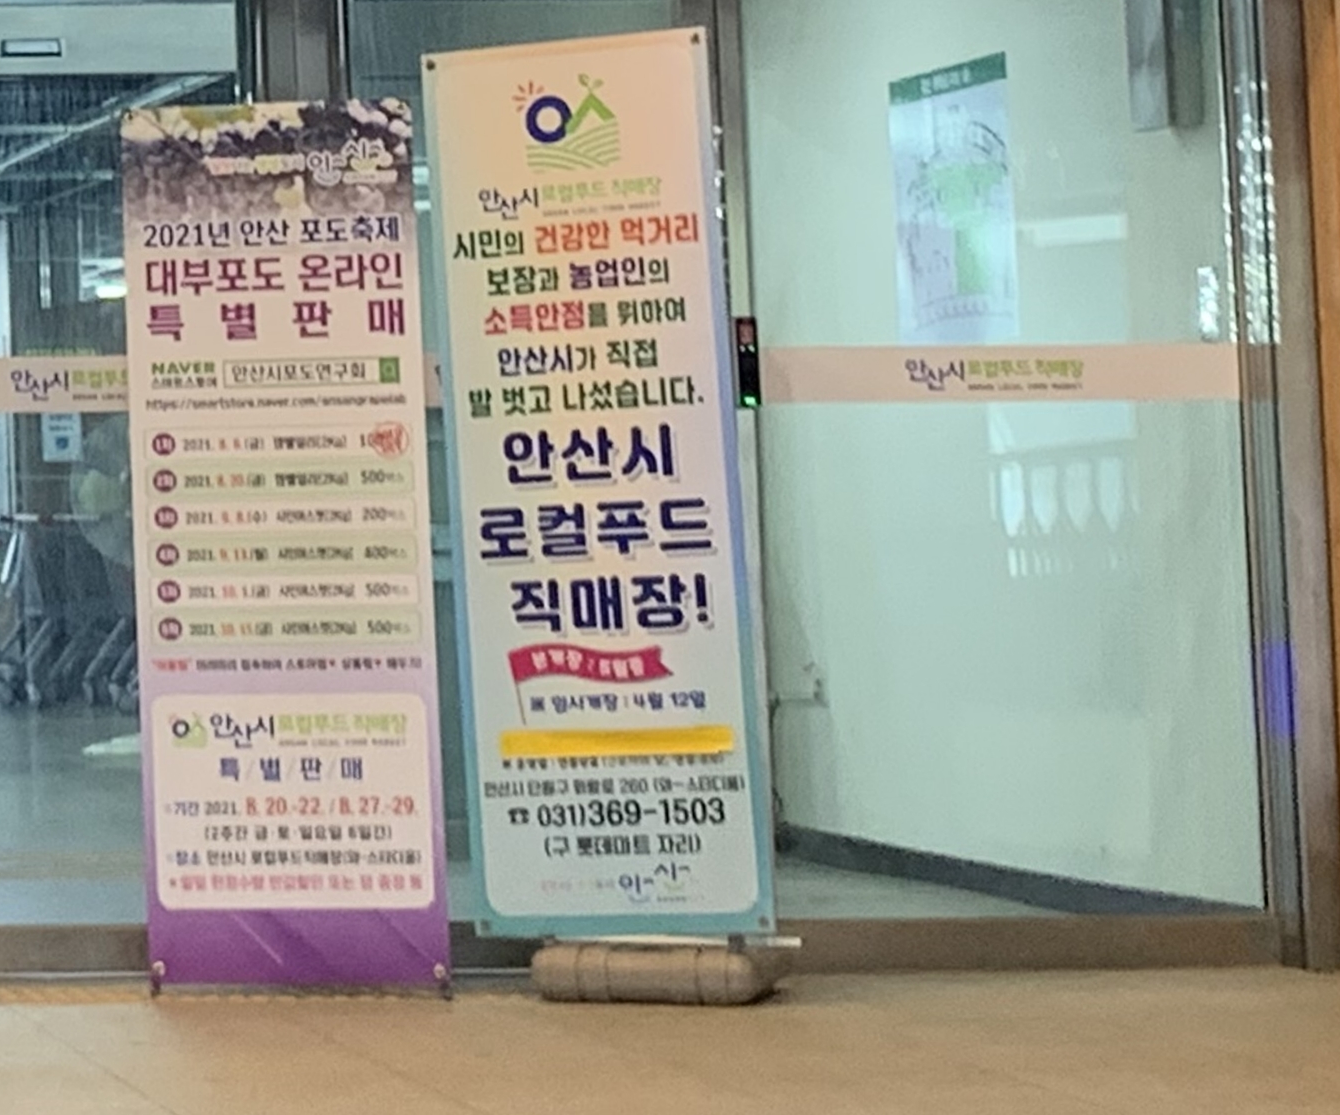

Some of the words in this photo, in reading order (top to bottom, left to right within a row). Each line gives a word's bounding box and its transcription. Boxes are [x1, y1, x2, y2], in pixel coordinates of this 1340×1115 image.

[478, 187, 539, 221] 안산시
[143, 221, 230, 247] 2021년
[240, 219, 290, 244] 안산
[300, 215, 399, 242] 포도축제
[453, 229, 525, 261] 시민의
[534, 221, 610, 255] 건강한
[620, 213, 700, 246] 먹거리
[146, 257, 285, 296] 대부포도
[298, 253, 403, 292] 온라인
[487, 265, 560, 297] 보장과
[569, 257, 670, 290] 농업인의
[147, 304, 184, 341] 특
[221, 302, 257, 340] 별
[293, 300, 332, 338] 판
[368, 298, 405, 335] 매
[617, 297, 686, 326] 위하여
[151, 361, 216, 376] NAVER
[498, 343, 597, 377] 안산시가
[606, 339, 658, 368] 직접
[905, 358, 965, 391] 안산시
[11, 370, 68, 401] 안산시
[469, 389, 493, 418] 발
[502, 386, 552, 416] 벗고
[561, 376, 705, 412] 나섰습니다.
[503, 423, 677, 485] 안산시
[480, 498, 713, 560] 로컬푸드
[510, 573, 710, 633] 직매장!
[210, 713, 275, 749] 안산시
[537, 799, 726, 827] 031)369-1503
[545, 838, 570, 858] (구
[576, 836, 651, 857] 롯데마트
[657, 835, 701, 855] 자리)
